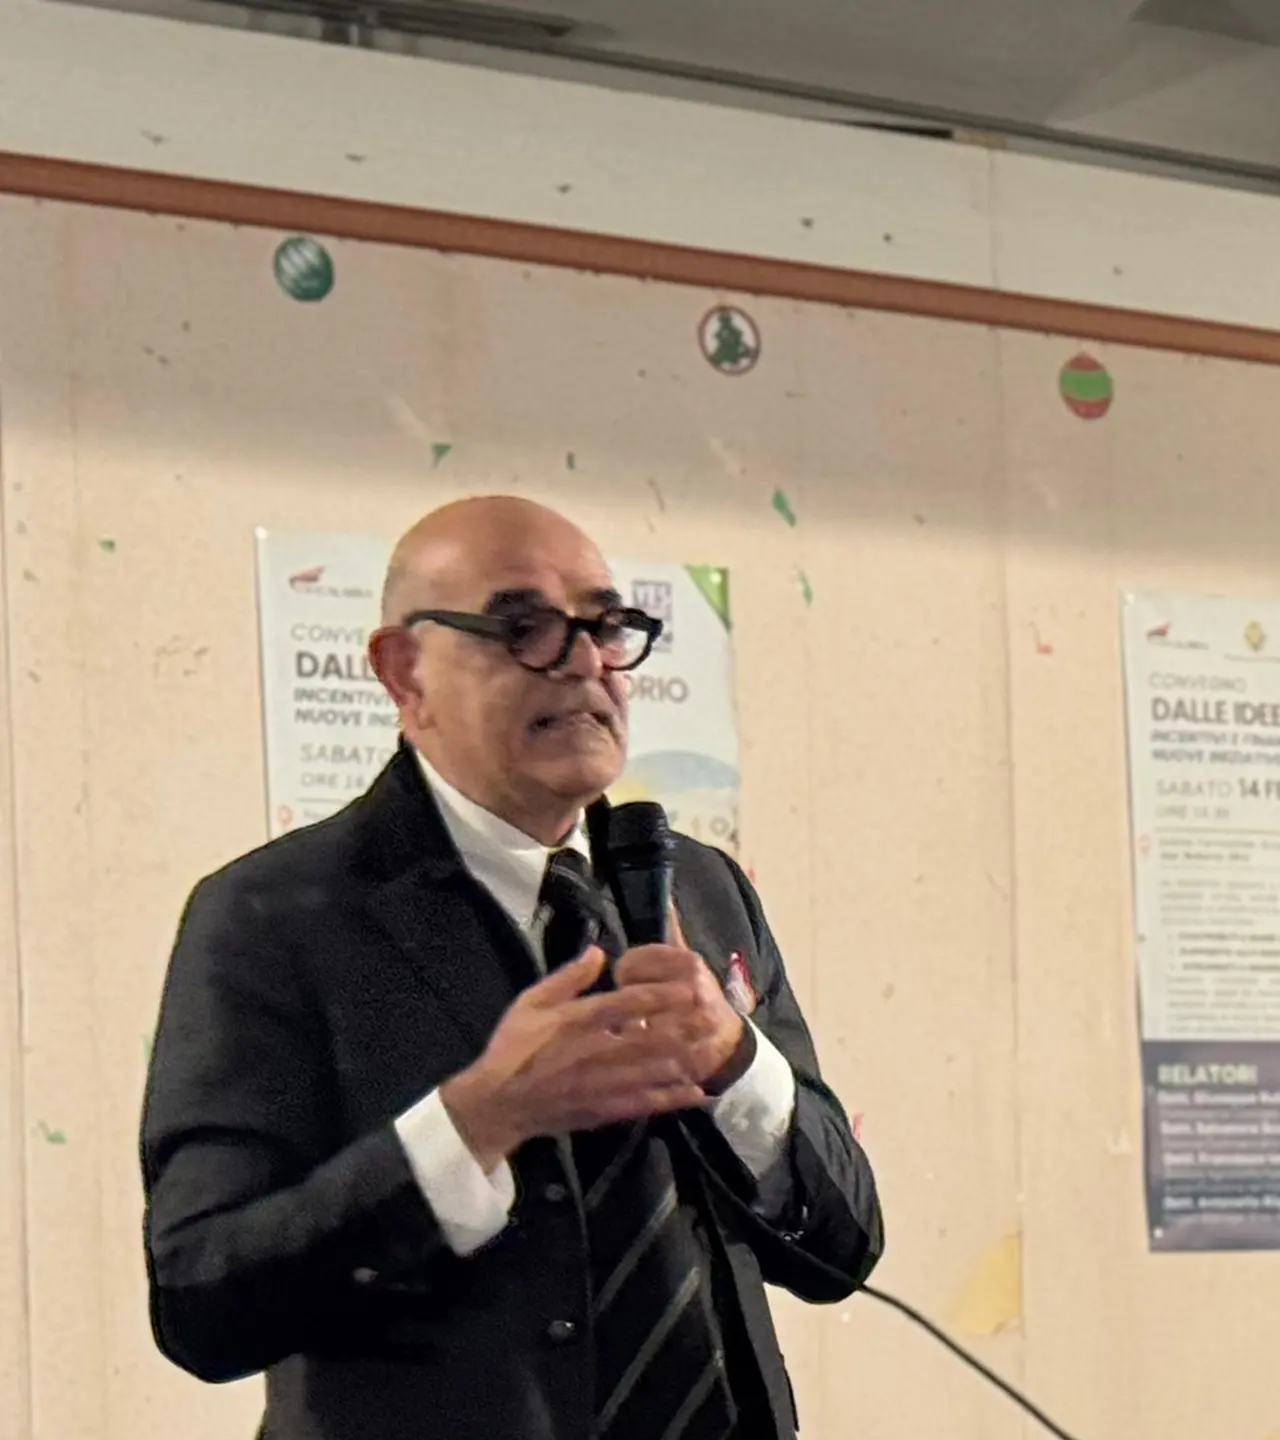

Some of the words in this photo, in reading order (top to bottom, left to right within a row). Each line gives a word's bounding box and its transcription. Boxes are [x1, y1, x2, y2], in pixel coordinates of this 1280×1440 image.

[290, 624, 365, 645] CONVE
[296, 650, 378, 682] DALL
[294, 708, 362, 727] NUOVE
[1151, 697, 1227, 724] DALLE
[1238, 777, 1261, 798] 14
[1157, 1064, 1258, 1085] RELATORI
